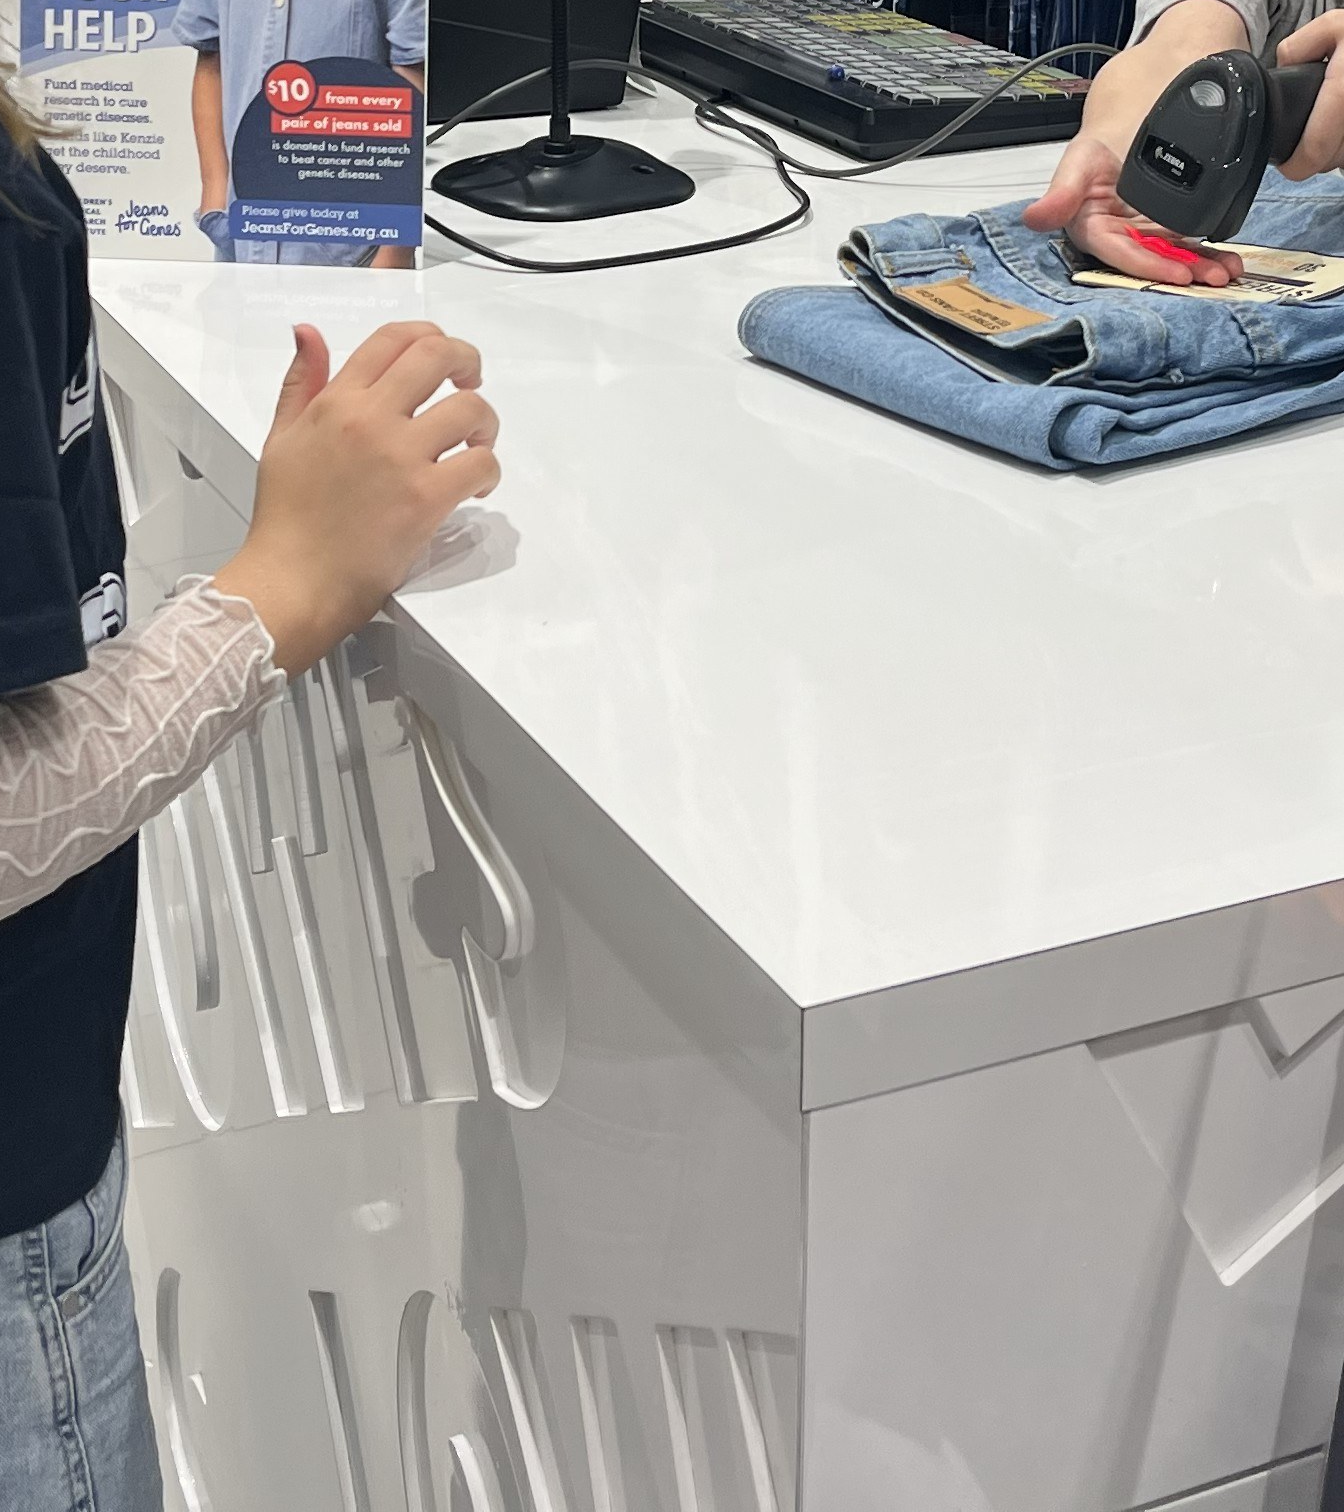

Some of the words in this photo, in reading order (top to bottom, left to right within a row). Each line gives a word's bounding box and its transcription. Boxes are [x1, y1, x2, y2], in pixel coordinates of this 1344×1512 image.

[44, 9, 156, 52] HELP
[44, 79, 77, 90] Fund
[80, 80, 133, 92] medical
[268, 78, 310, 102] $10
[325, 92, 358, 105] from
[362, 97, 403, 110] every
[44, 95, 100, 107] research
[103, 96, 116, 107] to
[118, 99, 148, 108] cure
[95, 111, 154, 124] diseases.
[281, 116, 311, 131] pair
[313, 118, 329, 129] of
[332, 119, 369, 133] jeans
[373, 119, 402, 132] sold
[93, 131, 117, 143] like
[120, 132, 165, 145] Kenzie
[68, 146, 90, 158] the
[92, 147, 161, 160] childhood
[272, 140, 280, 150] is
[282, 140, 326, 152] donated
[328, 142, 339, 152] to
[341, 141, 364, 153] fund
[366, 144, 411, 155] research
[76, 161, 130, 174] deserve.
[278, 154, 288, 164] to
[291, 154, 315, 164] beat
[317, 157, 352, 166] cancer
[354, 156, 375, 167] and
[376, 157, 405, 168] other
[297, 169, 335, 181] genetic
[337, 169, 383, 181] diseases.
[125, 200, 169, 218] Jeans
[242, 205, 280, 216] Please
[282, 207, 308, 220] give
[310, 208, 344, 222] today
[346, 209, 359, 220] at
[115, 213, 139, 233] for
[140, 218, 182, 237] Genes
[241, 220, 399, 241] JeansForGenes.org.au
